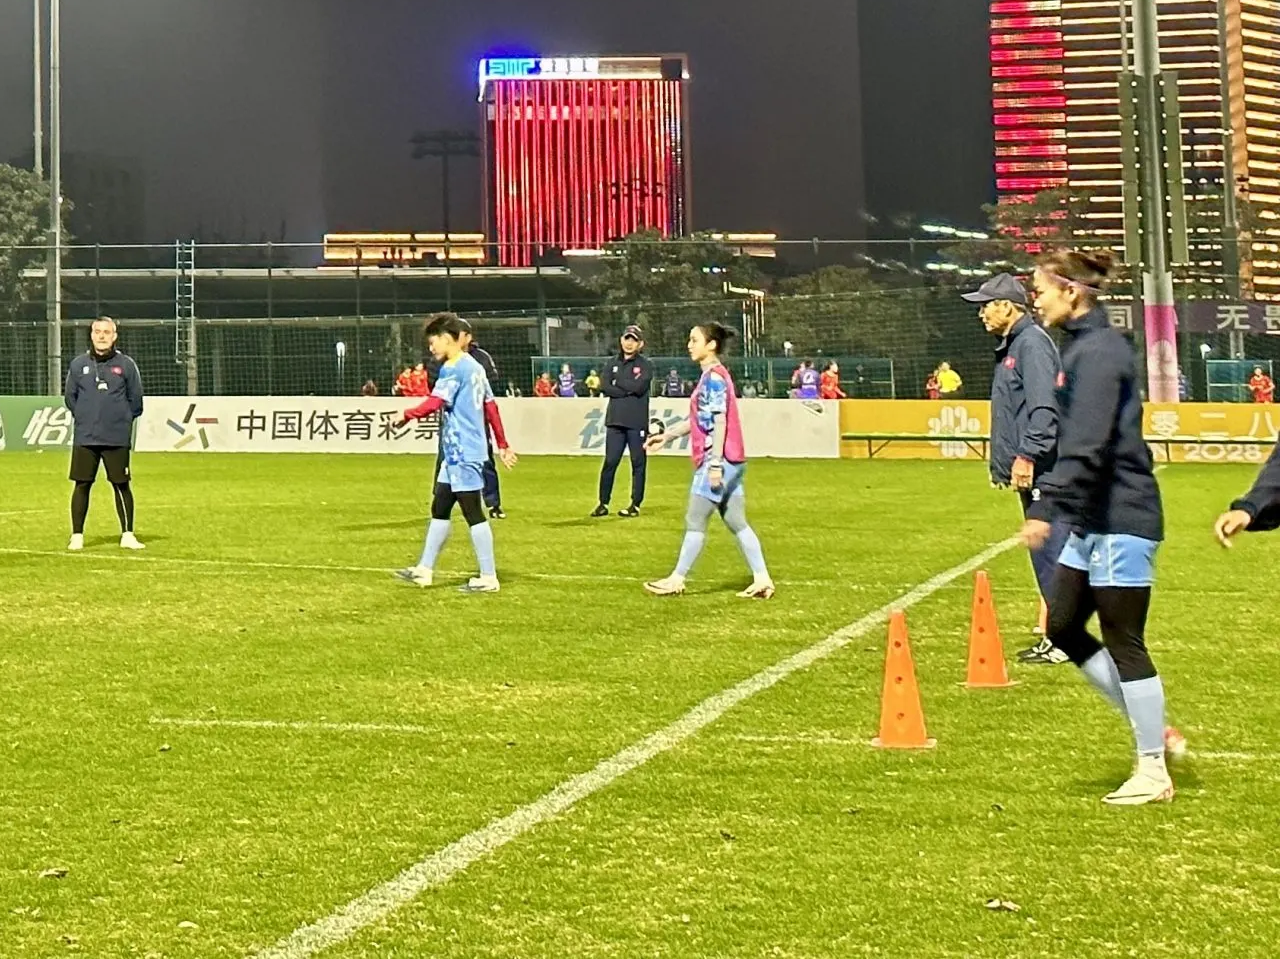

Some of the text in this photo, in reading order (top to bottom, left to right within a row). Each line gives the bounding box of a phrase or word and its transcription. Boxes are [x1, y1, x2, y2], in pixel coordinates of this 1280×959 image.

[22, 406, 74, 446] 怡
[237, 409, 440, 441] 中国体育彩票
[1183, 443, 1263, 461] 2028
